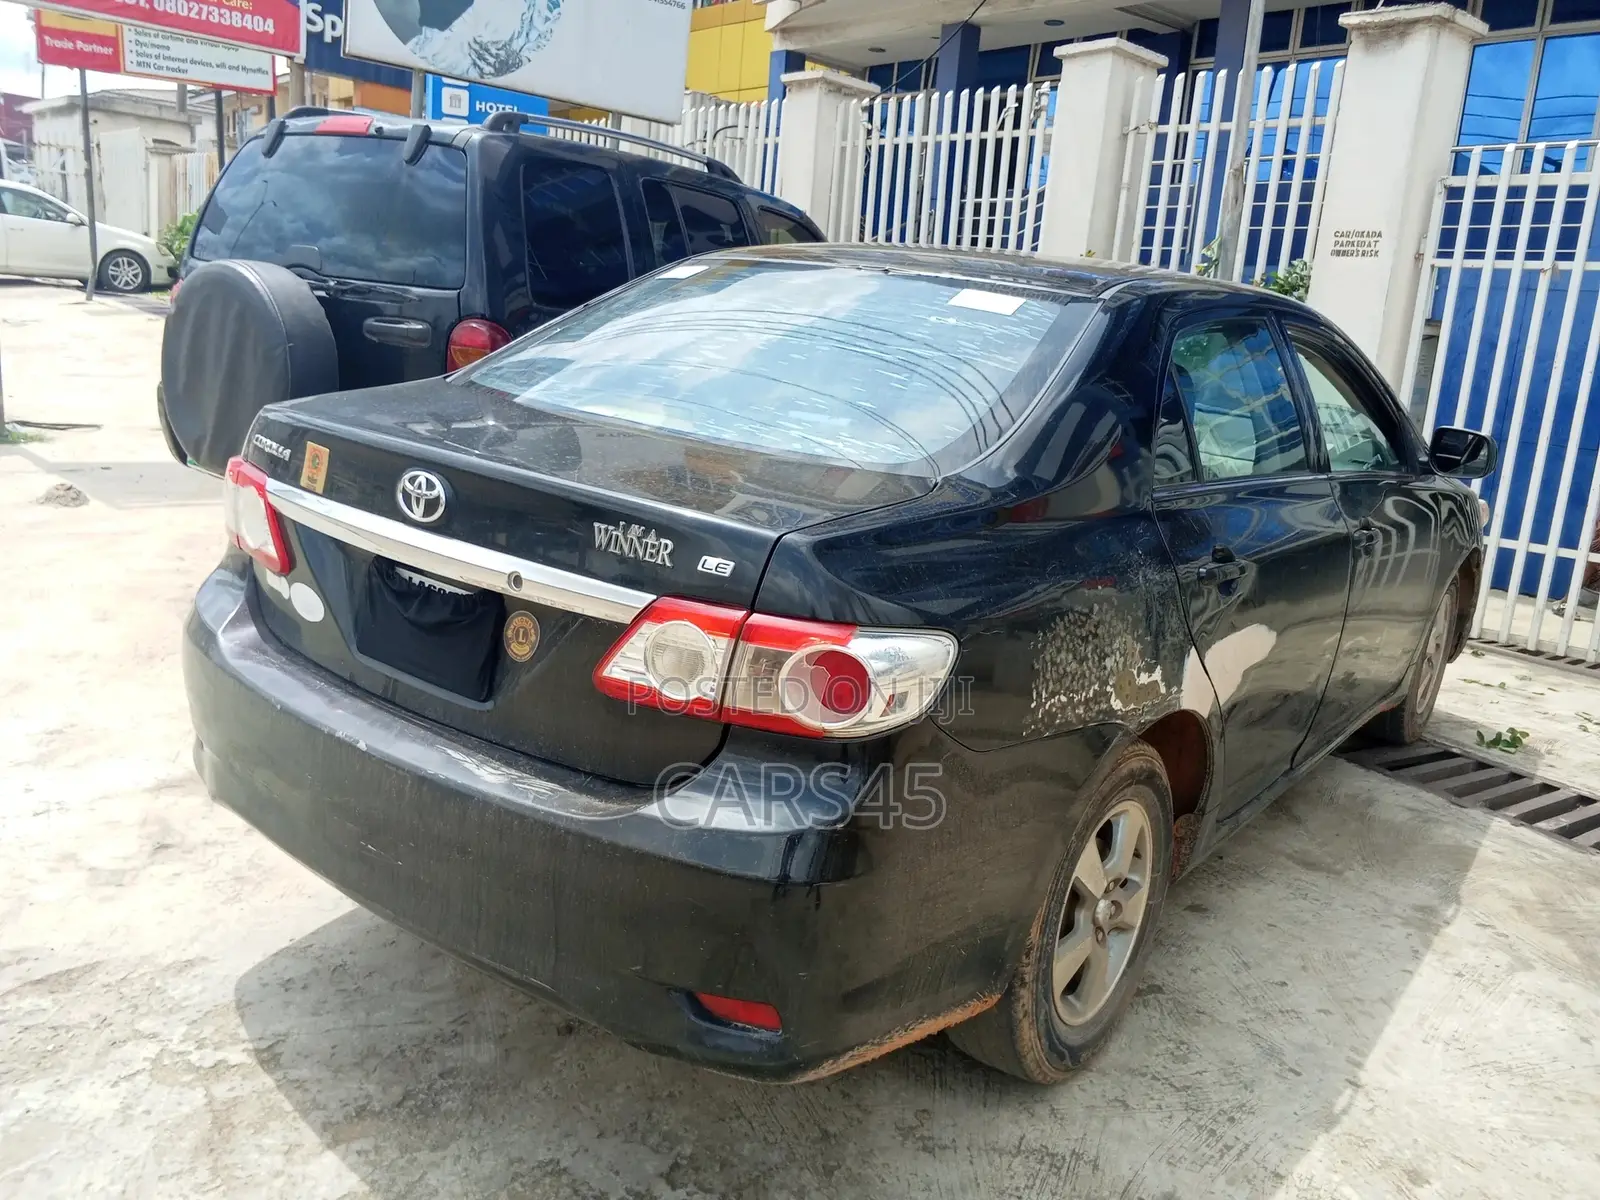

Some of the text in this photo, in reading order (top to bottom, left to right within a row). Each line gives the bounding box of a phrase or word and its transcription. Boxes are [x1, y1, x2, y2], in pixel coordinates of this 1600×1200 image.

[153, 0, 275, 35] 08027338404
[134, 28, 152, 38] Sales
[43, 34, 114, 55] Trade Partner
[136, 50, 153, 59] Sales
[228, 63, 240, 72] and
[136, 60, 188, 74] MTN Car tracker
[1361, 249, 1380, 257] RISK
[592, 521, 674, 569] WINNER
[701, 557, 731, 575] LE
